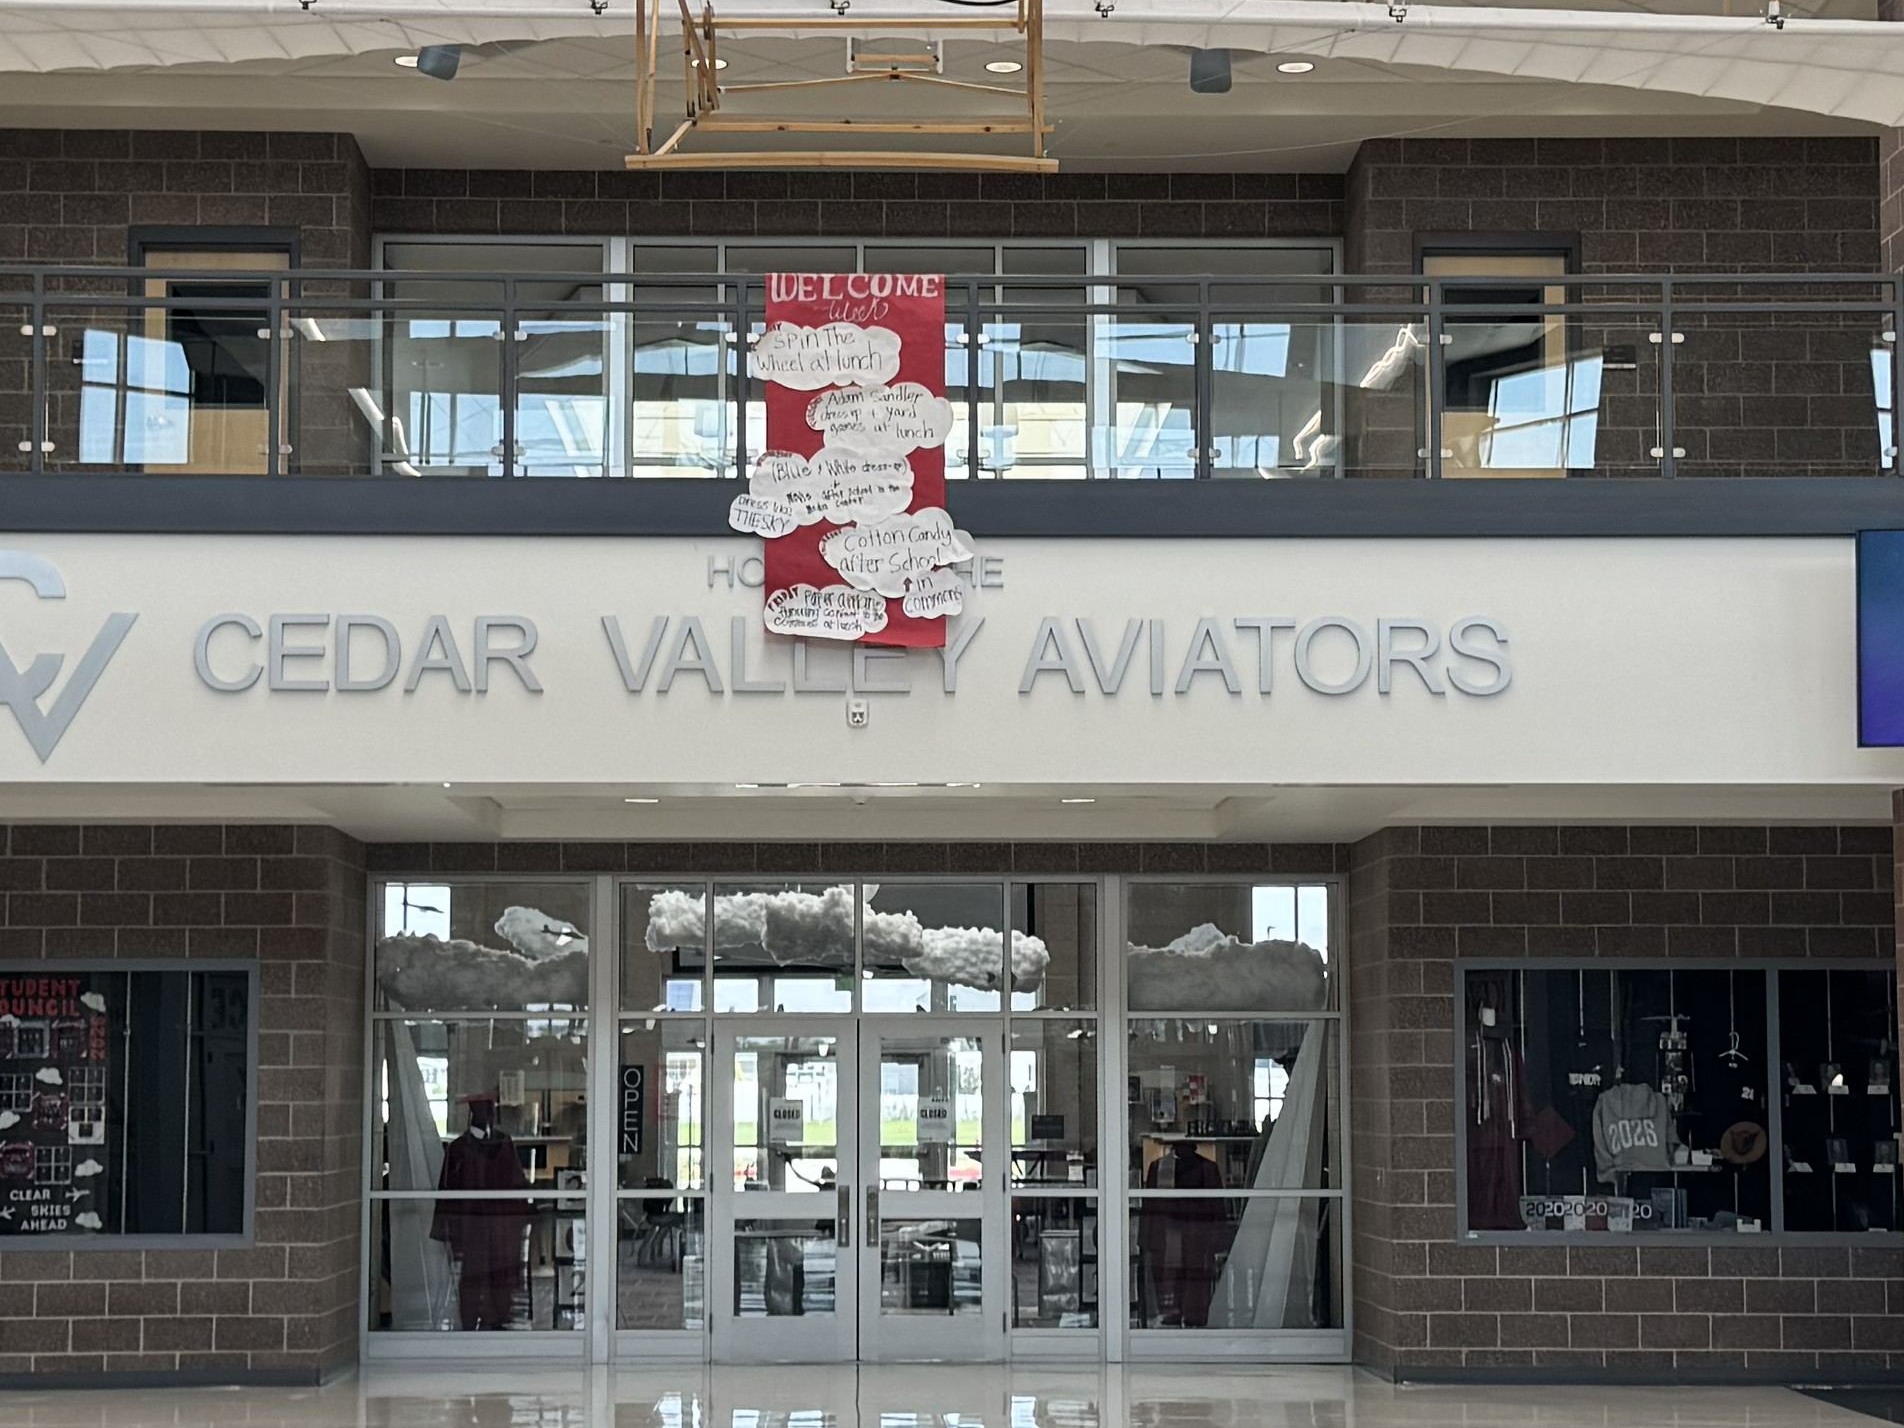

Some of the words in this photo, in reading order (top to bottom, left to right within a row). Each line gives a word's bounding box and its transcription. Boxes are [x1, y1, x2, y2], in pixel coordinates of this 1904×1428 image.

[771, 273, 939, 302] WELCOME
[809, 352, 830, 372] at
[836, 341, 883, 372] lunch
[195, 613, 544, 694] CEDAR
[602, 614, 985, 694] VALLEY
[1017, 616, 1513, 697] AVIATORS
[623, 1067, 641, 1153] OPEN
[9, 1189, 51, 1201] CLEAR
[20, 1219, 68, 1231] AHEAD
[30, 1204, 72, 1217] SKIES
